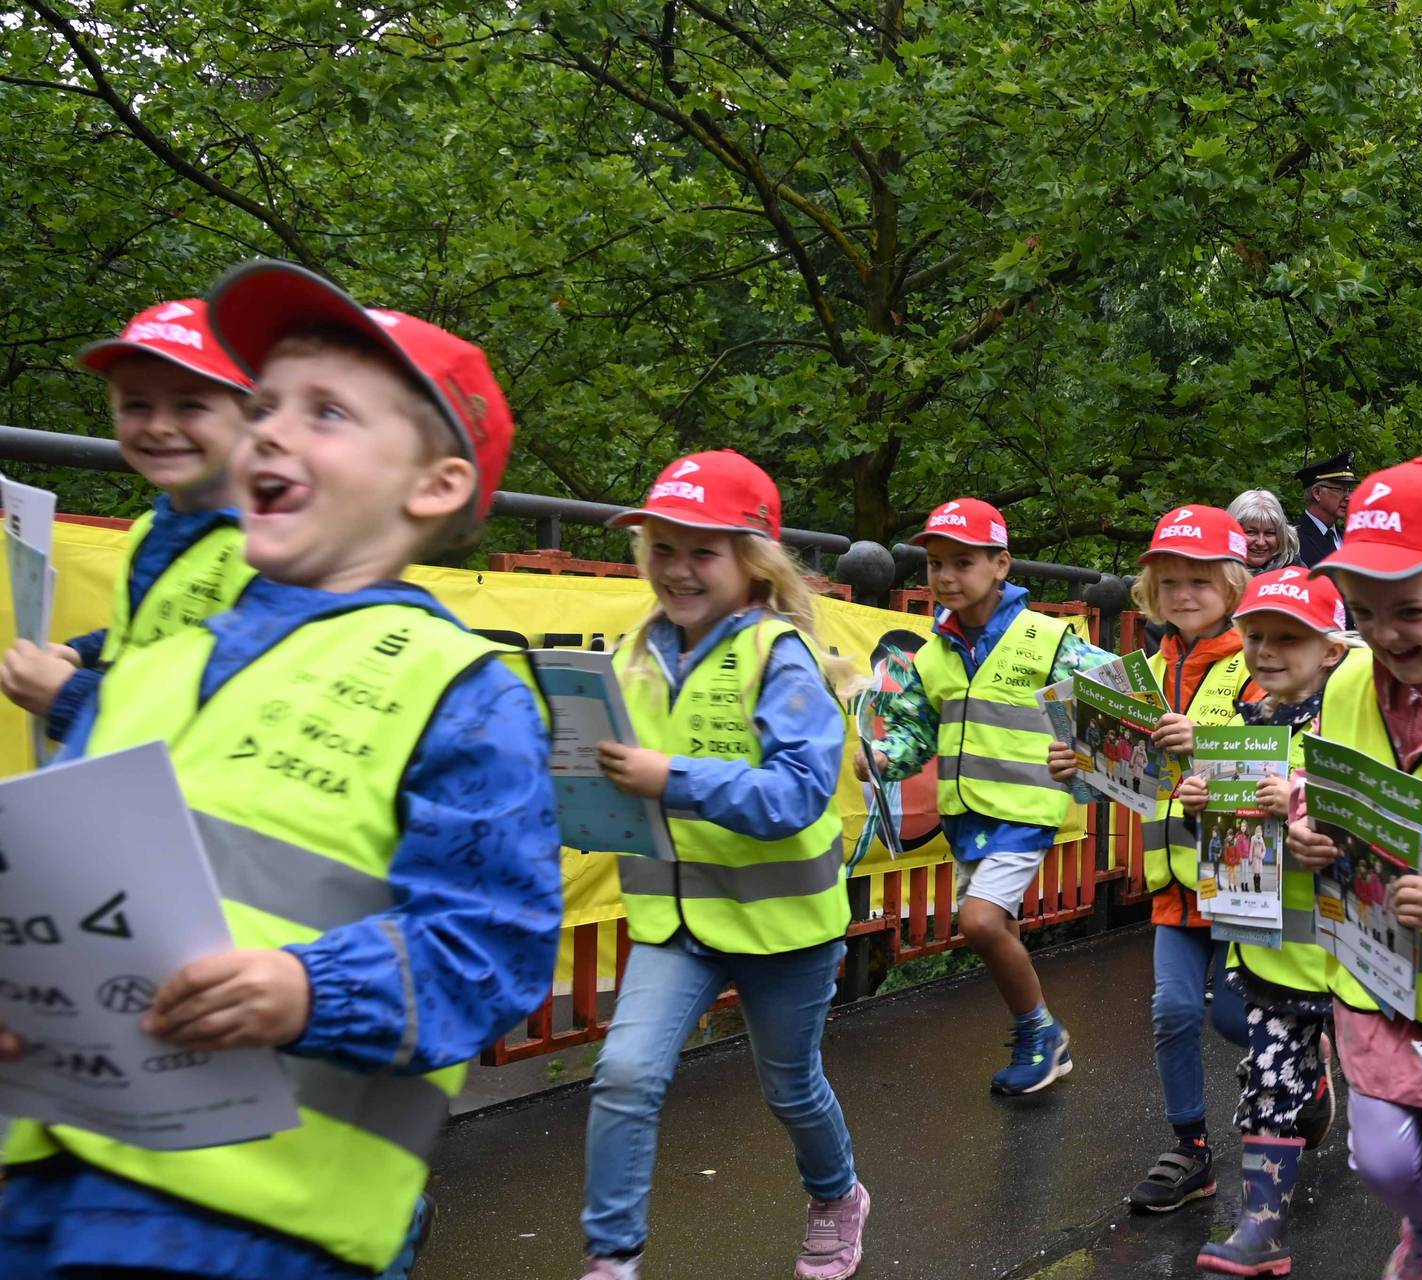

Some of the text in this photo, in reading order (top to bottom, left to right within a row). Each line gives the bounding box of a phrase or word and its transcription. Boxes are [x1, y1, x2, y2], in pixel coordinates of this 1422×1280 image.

[929, 514, 967, 527] DEKRA
[1159, 524, 1202, 539] DEKRA
[1257, 583, 1310, 604] DEKRA
[1131, 662, 1147, 692] Siche
[1079, 681, 1105, 701] Sicher
[1108, 700, 1124, 711] zur
[1128, 705, 1158, 725] Schule
[1223, 741, 1241, 750] zur
[1244, 737, 1278, 751] Schule
[266, 750, 348, 795] DEKRA
[1223, 793, 1239, 802] zur
[813, 1219, 835, 1228] FILA
